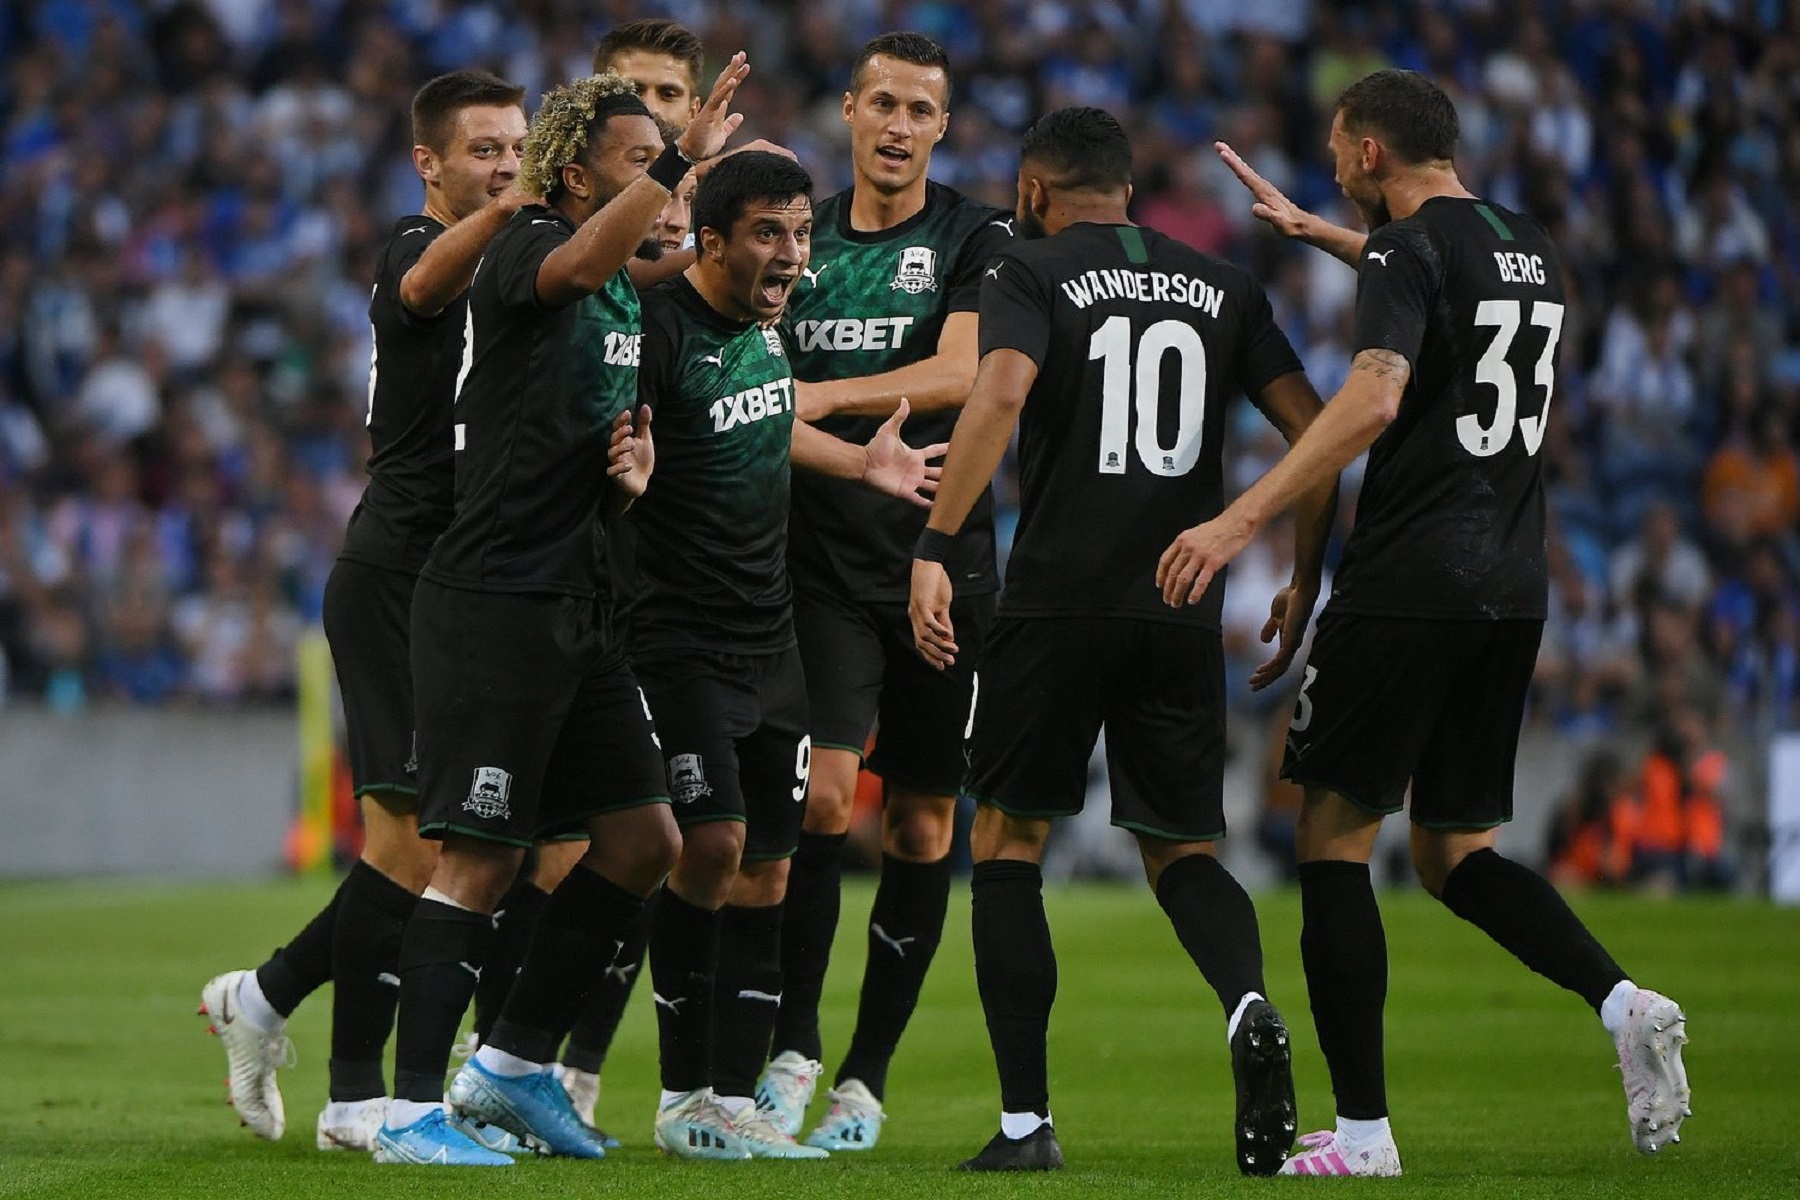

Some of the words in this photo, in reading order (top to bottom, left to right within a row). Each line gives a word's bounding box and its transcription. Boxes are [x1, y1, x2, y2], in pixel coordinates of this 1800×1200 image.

[1061, 269, 1225, 319] WANDERSON
[1493, 251, 1546, 285] BERG
[603, 331, 646, 367] 1XBE
[795, 316, 914, 352] 1XBET
[1088, 315, 1206, 477] 10
[1455, 299, 1565, 457] 33
[709, 377, 792, 433] 1XBET
[792, 733, 811, 802] 9
